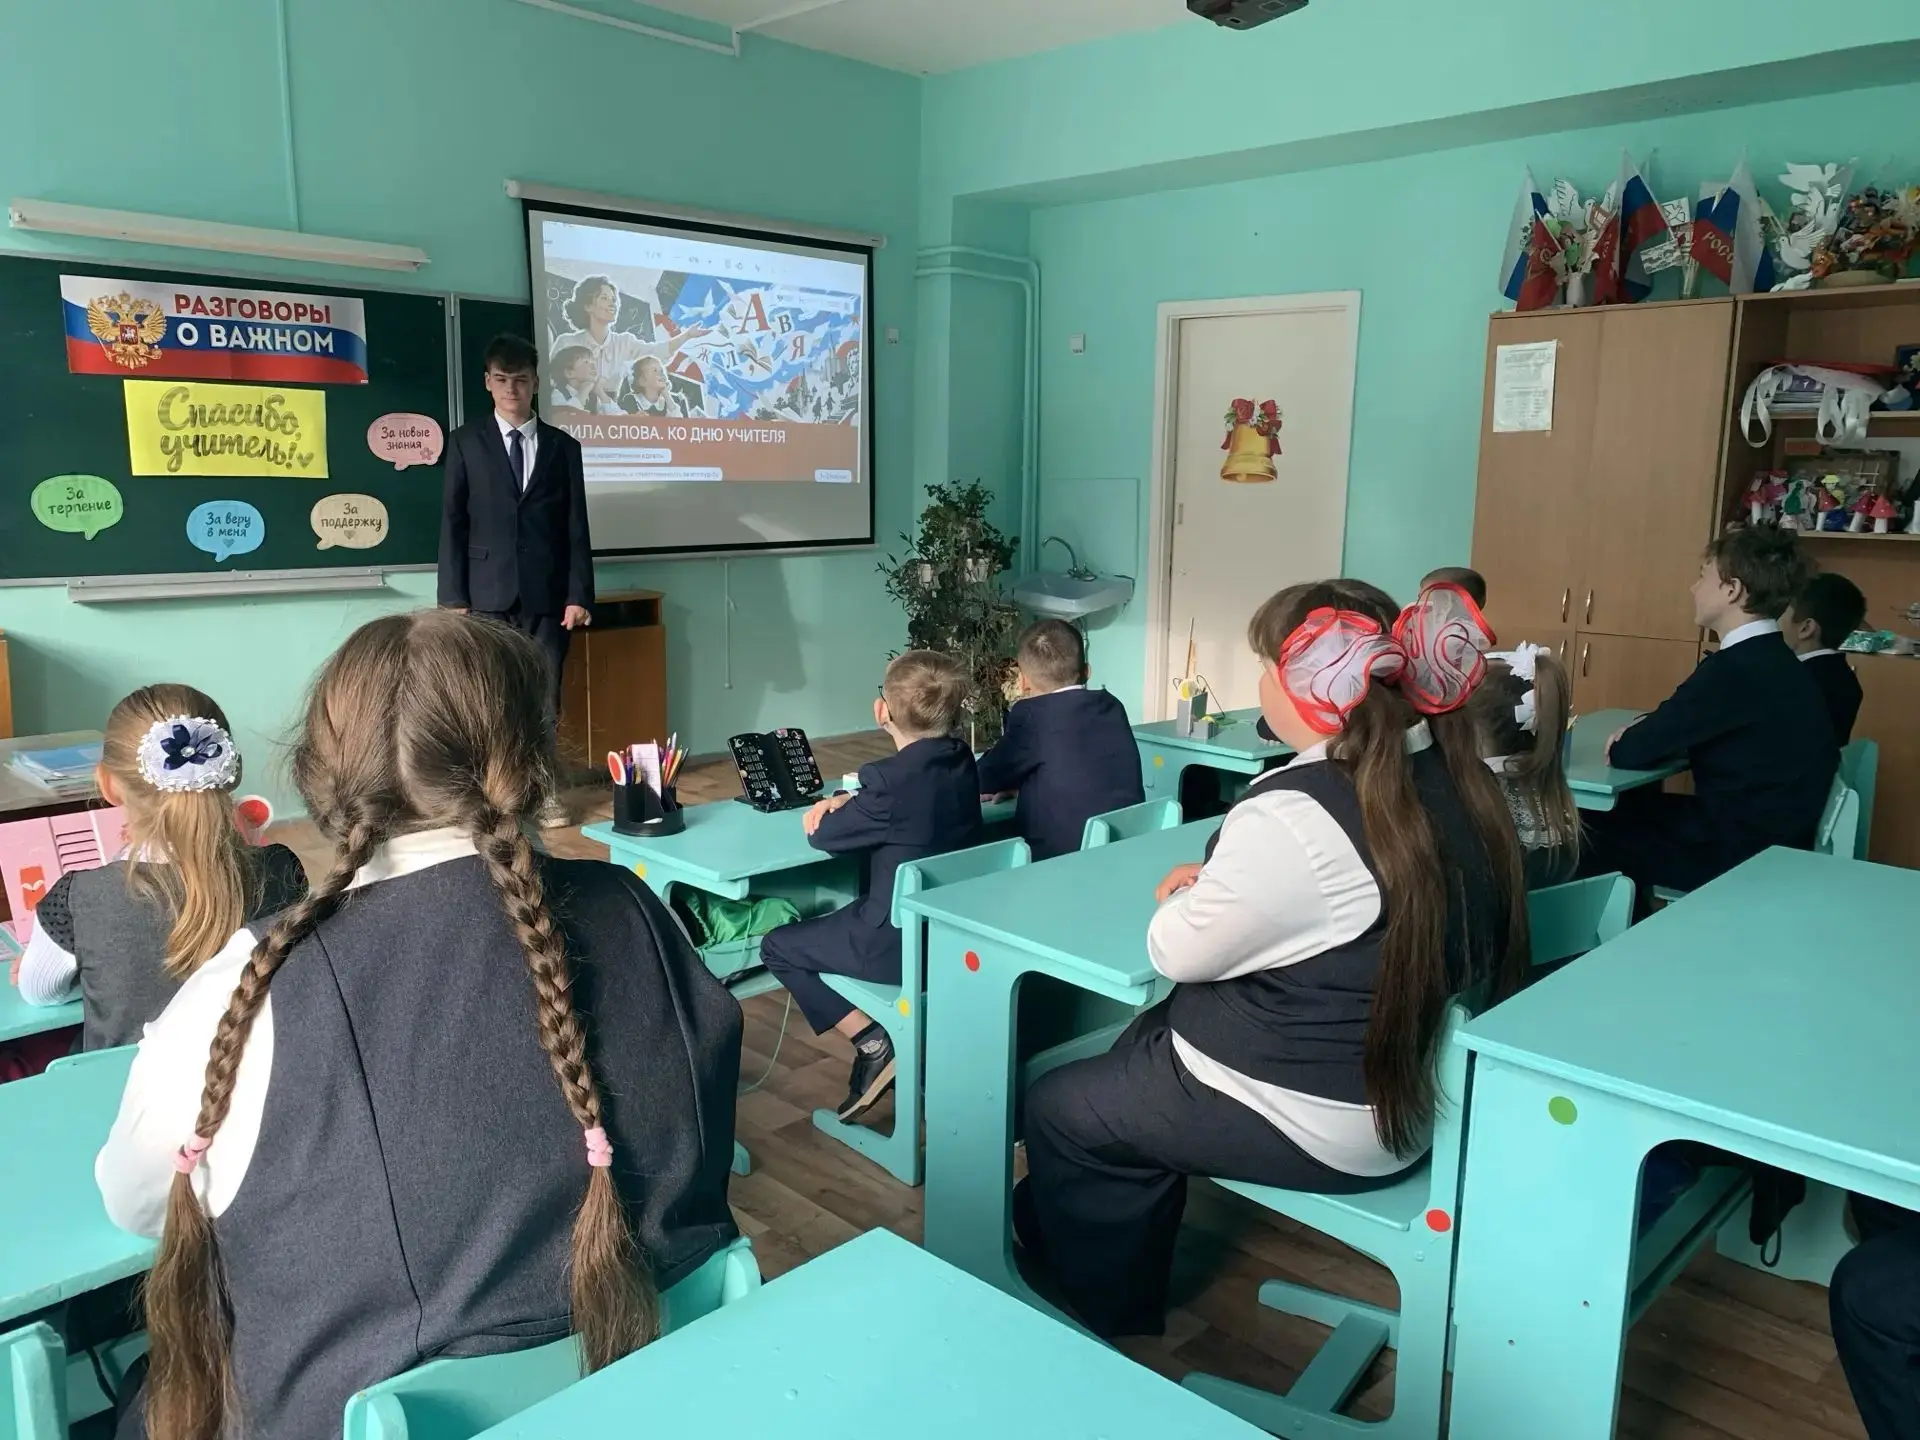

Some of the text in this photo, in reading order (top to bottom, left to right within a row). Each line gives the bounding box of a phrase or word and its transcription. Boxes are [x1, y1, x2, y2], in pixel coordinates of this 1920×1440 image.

[174, 294, 331, 324] РАЗГОВОРЫ
[736, 293, 772, 334] А
[176, 322, 334, 353] О ВАЖНОМ
[790, 334, 805, 361] Я
[157, 386, 302, 441] Спасибо,
[381, 426, 431, 439] За новые
[608, 425, 664, 441] СЛОВА.
[668, 426, 687, 441] КО
[690, 427, 724, 444] ДНЮ
[726, 428, 786, 444] УЧИТЕЛЯ
[161, 433, 298, 473] учитель!
[386, 441, 422, 451] знания
[66, 487, 85, 500] За
[48, 500, 112, 517] терпение
[343, 502, 358, 515] За
[205, 512, 251, 529] За веру
[321, 517, 382, 532] поддержку
[207, 527, 247, 537] в меня
